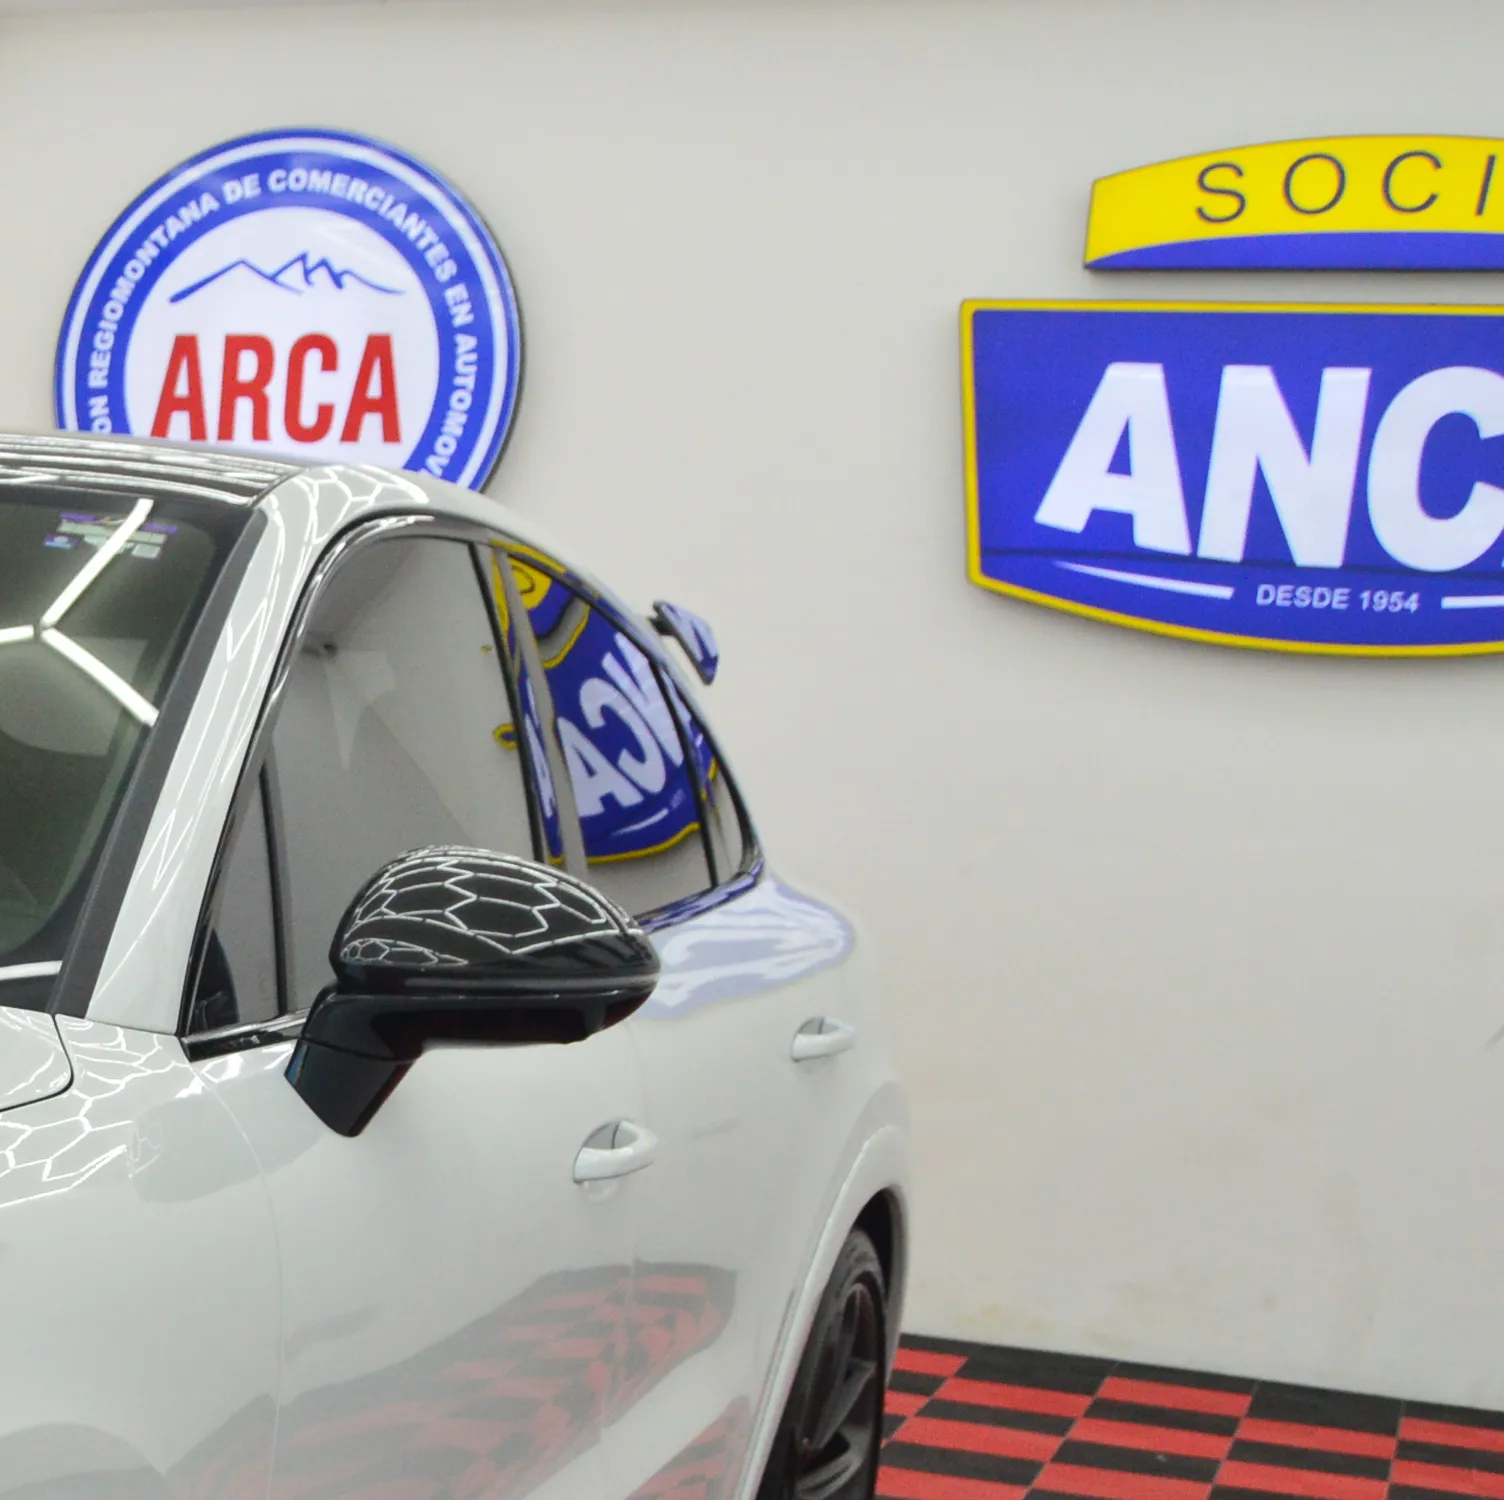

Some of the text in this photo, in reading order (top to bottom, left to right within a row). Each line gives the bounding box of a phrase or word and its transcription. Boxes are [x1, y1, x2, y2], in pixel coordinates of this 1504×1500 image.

[87, 168, 478, 477] ON REGIOMONTANA DE COMERCIANTES EN AUTOMOV
[150, 332, 403, 444] ARCA
[1033, 361, 1504, 572] ANC
[1256, 583, 1420, 614] DESDE 1954
